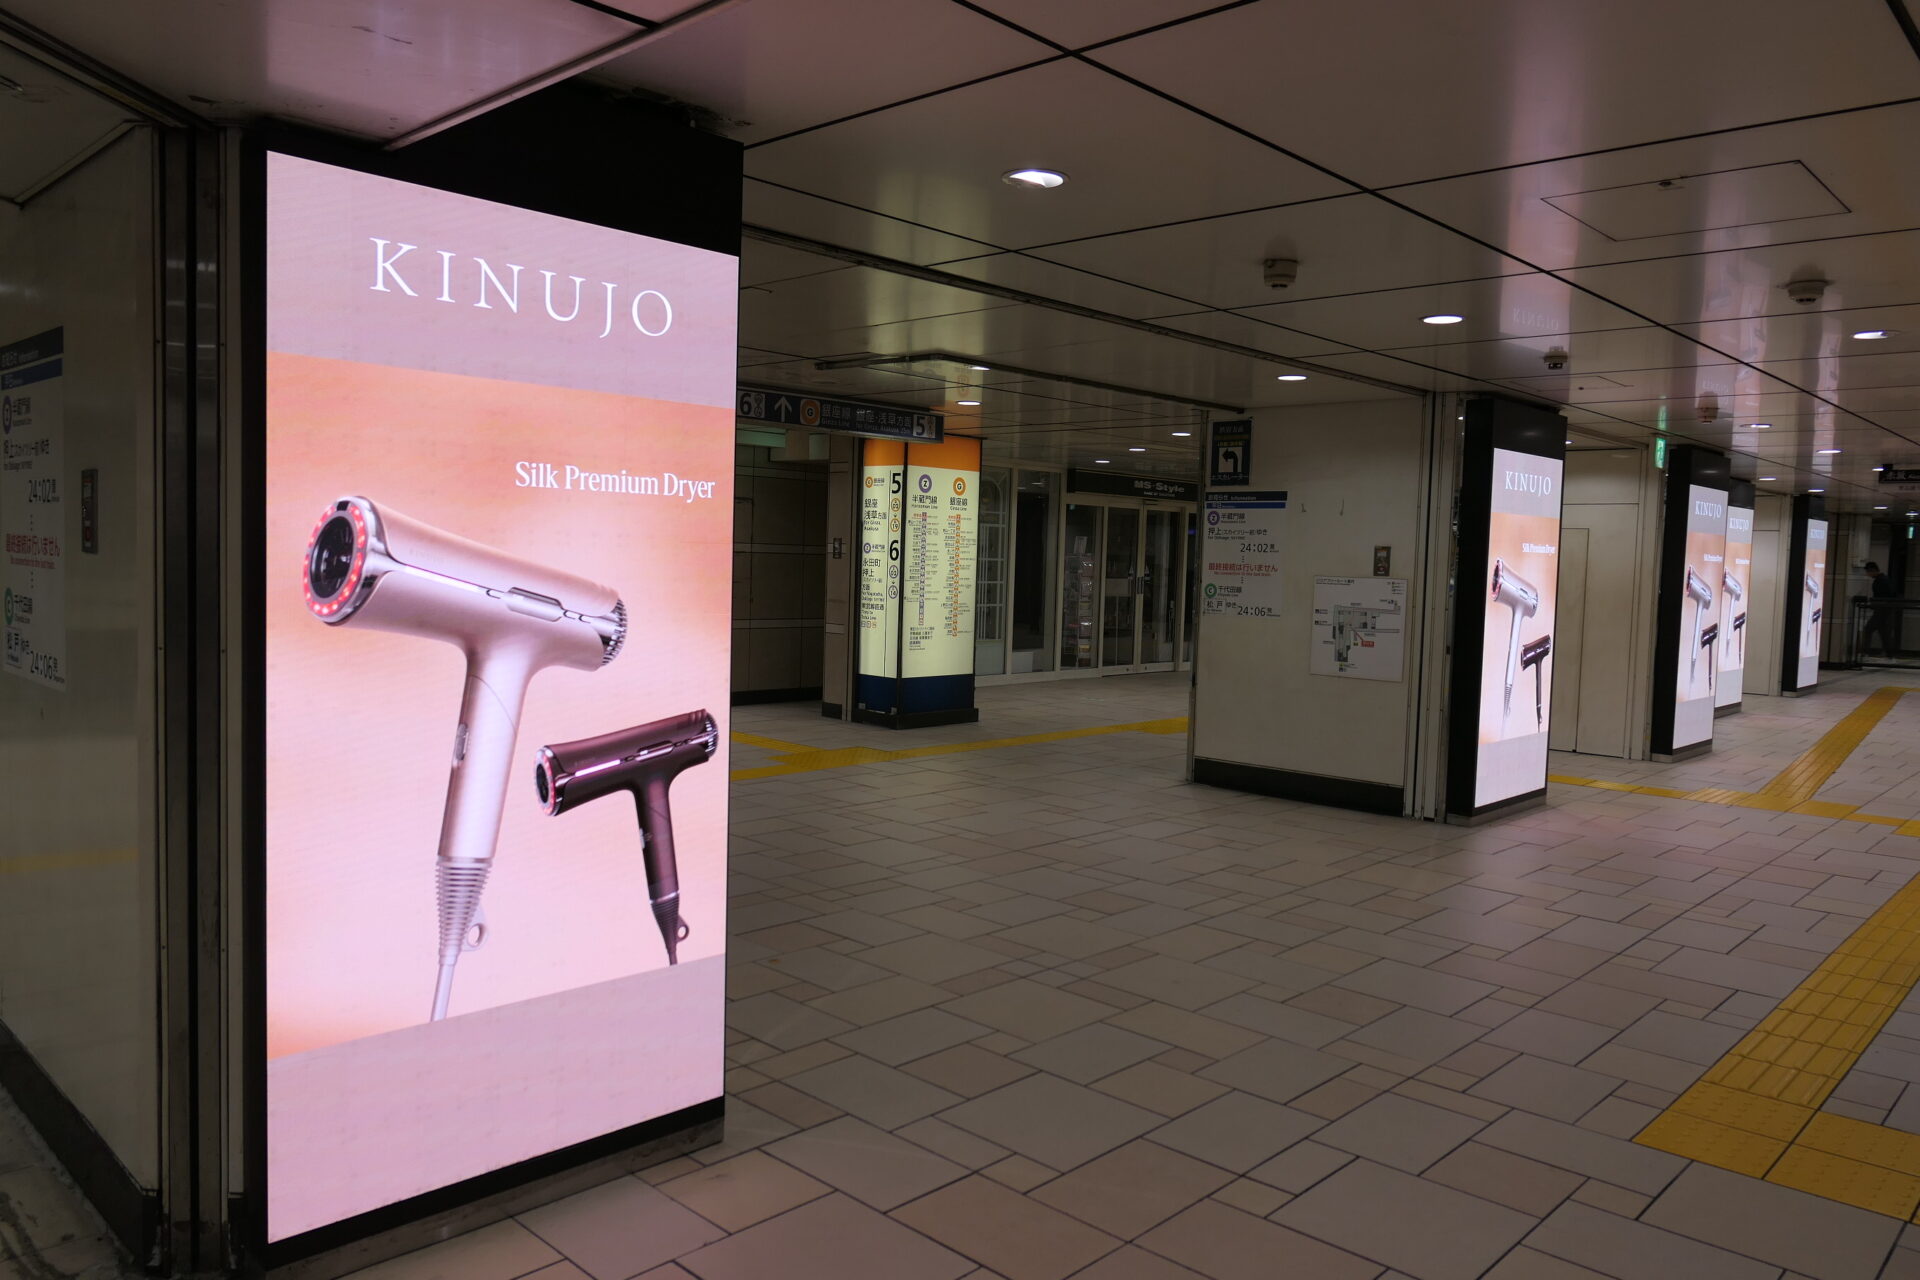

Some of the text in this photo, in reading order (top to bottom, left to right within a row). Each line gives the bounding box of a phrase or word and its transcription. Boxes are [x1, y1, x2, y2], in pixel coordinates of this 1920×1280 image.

[369, 237, 673, 338] KINUJO
[739, 393, 751, 415] 6
[916, 416, 925, 436] 5
[515, 461, 716, 504] Silk Premium Dryer
[891, 473, 901, 494] 5
[1505, 471, 1552, 497] KINUJO
[1695, 500, 1722, 519] KINUJO
[889, 540, 899, 561] 6
[1240, 543, 1268, 552] 24:02
[1237, 606, 1266, 616] 24:06
